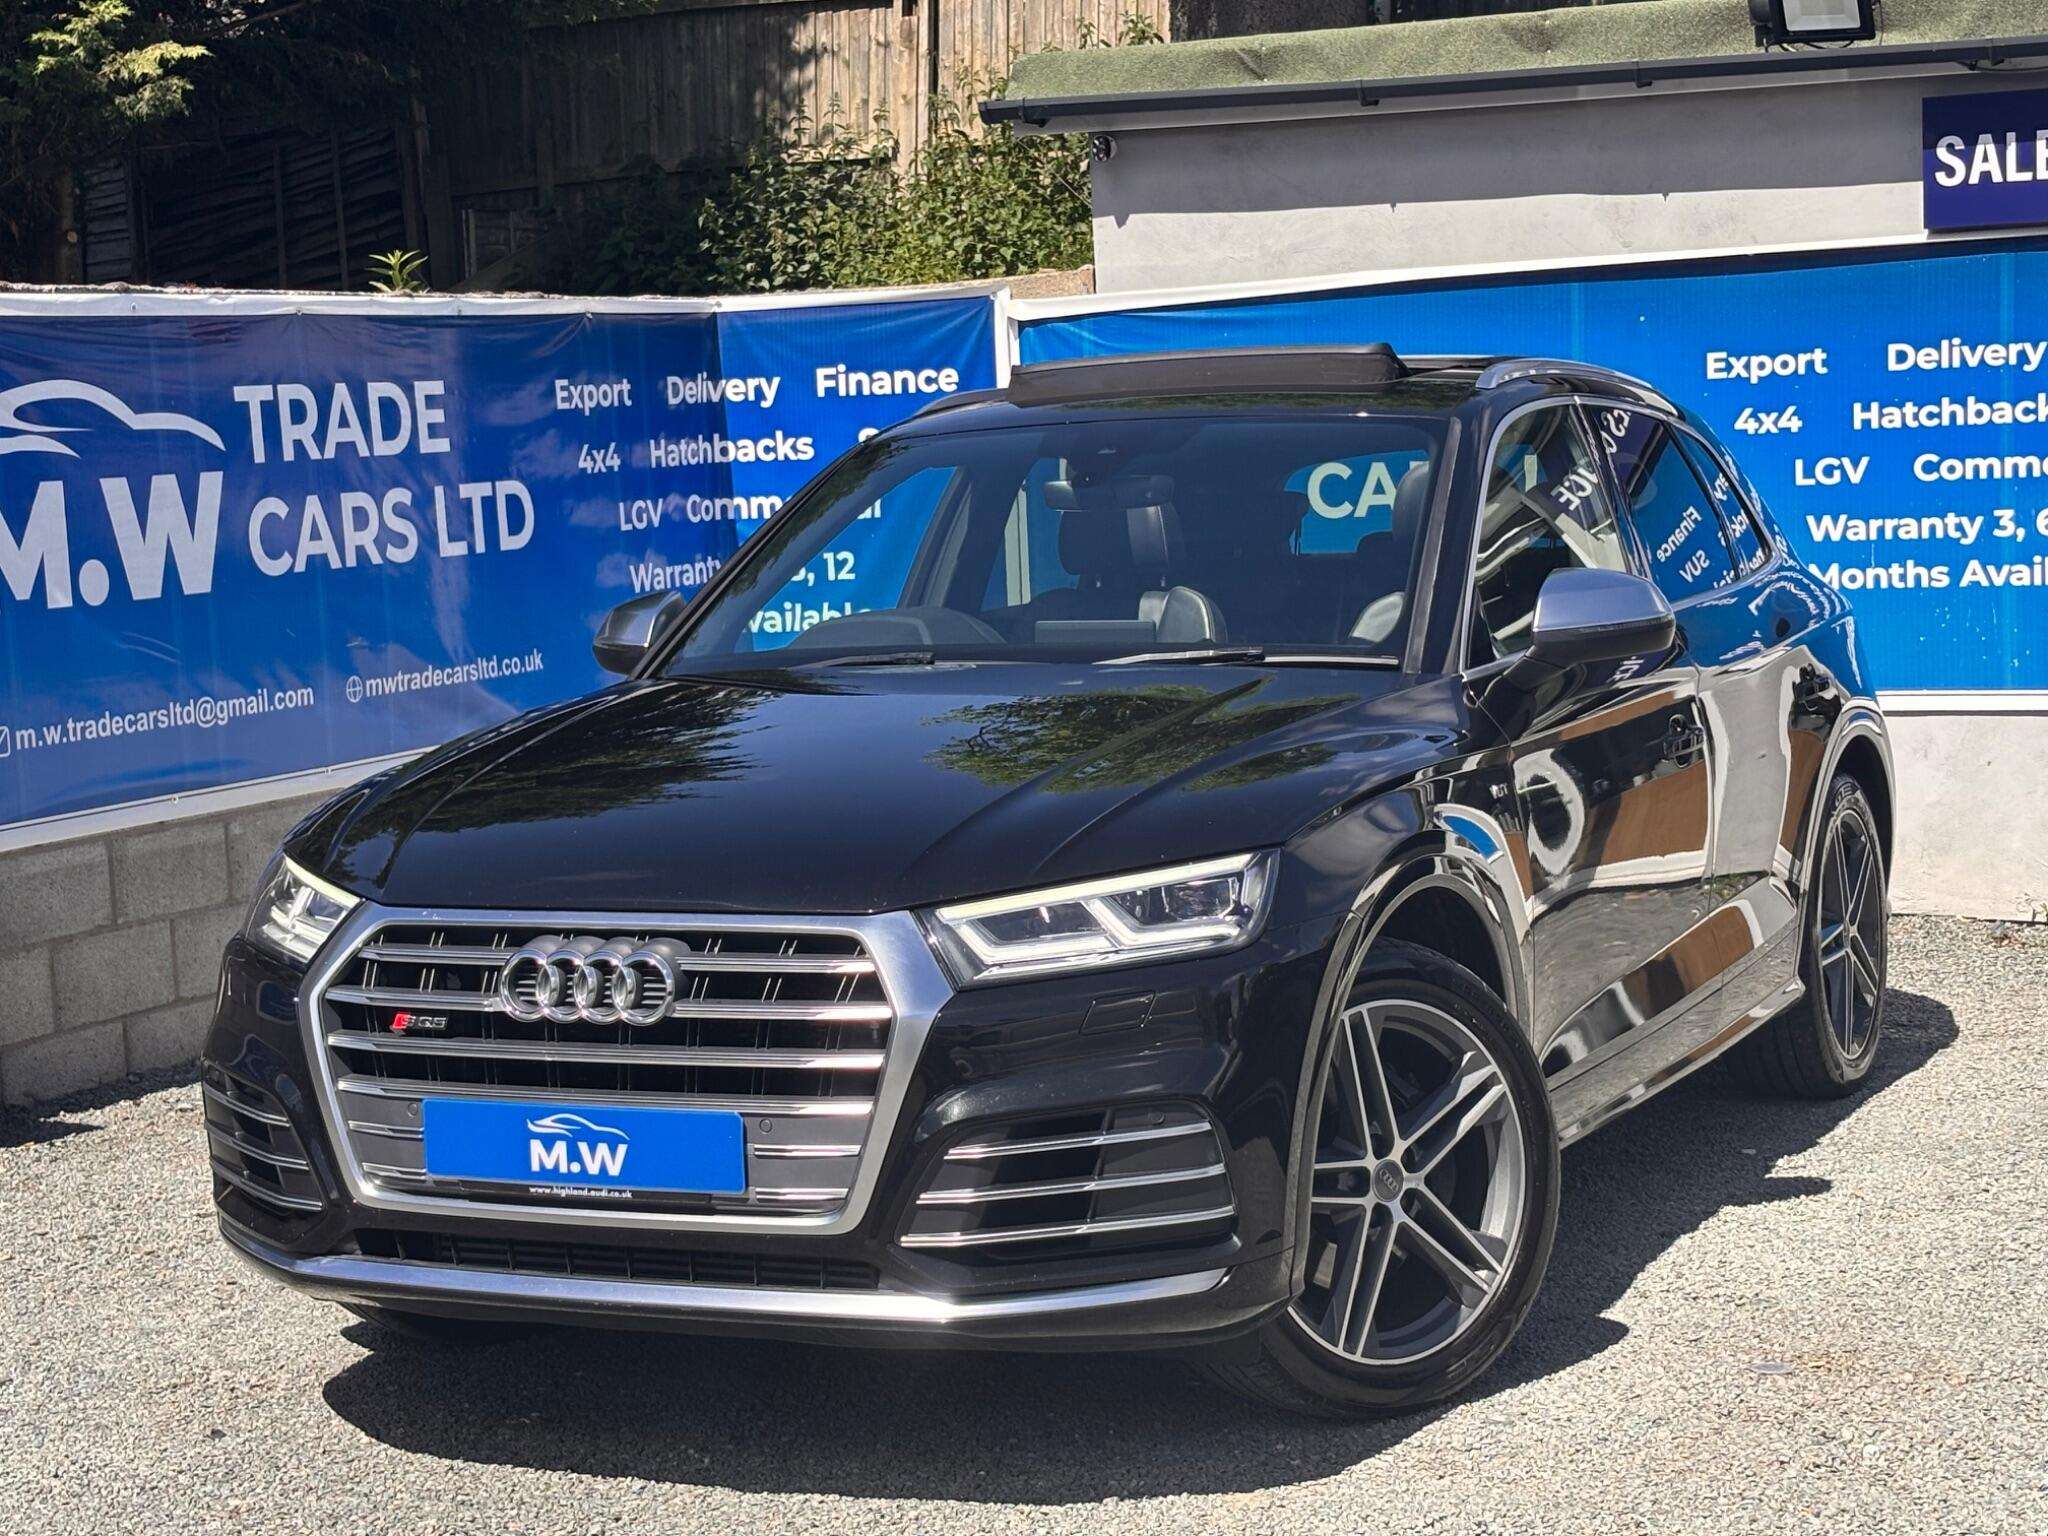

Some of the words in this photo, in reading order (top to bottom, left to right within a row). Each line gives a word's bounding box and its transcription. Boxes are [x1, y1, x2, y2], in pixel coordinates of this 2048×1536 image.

[1706, 348, 1828, 384] Export
[1888, 338, 2048, 372] Delivery
[555, 378, 632, 416] Export
[667, 372, 781, 408] Delivery
[815, 364, 960, 398] Finance
[233, 379, 451, 464] TRADE
[1734, 405, 1802, 434] 4x4
[578, 442, 621, 474] 4x4
[650, 431, 815, 469] Hatchbacks
[1795, 456, 1870, 486] LGV
[1914, 454, 2048, 482] Comm
[248, 487, 419, 577] CARS
[435, 479, 535, 558] LTD
[619, 498, 663, 532] LGV
[1806, 511, 1984, 545] Warranty
[1993, 509, 2025, 542] 3,
[0, 470, 224, 610] M.W
[823, 551, 856, 581] 12
[1809, 560, 1950, 590] Months
[365, 649, 543, 698] mwtradecarsltd.co.uk
[15, 686, 314, 750] m.w.tradecarsltd@gmail.com
[529, 1139, 628, 1177] M.W
